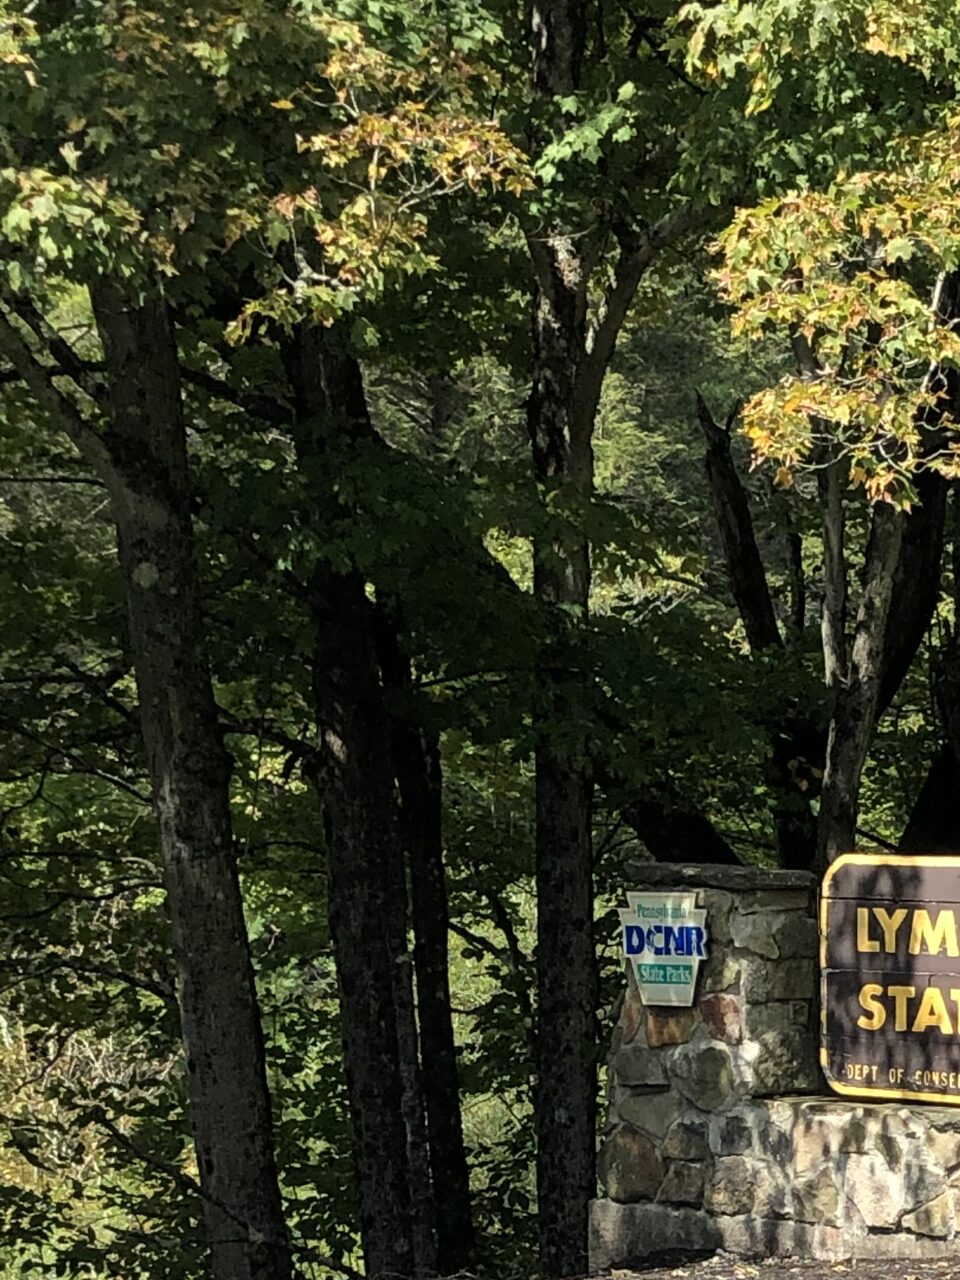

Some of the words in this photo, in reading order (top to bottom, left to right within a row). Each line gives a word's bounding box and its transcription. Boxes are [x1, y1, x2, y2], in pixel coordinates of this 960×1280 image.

[625, 925, 705, 956] DCNR
[640, 964, 665, 982] State
[666, 966, 691, 982] Parks
[847, 1064, 878, 1082] DEPT
[889, 1068, 905, 1084] OF
